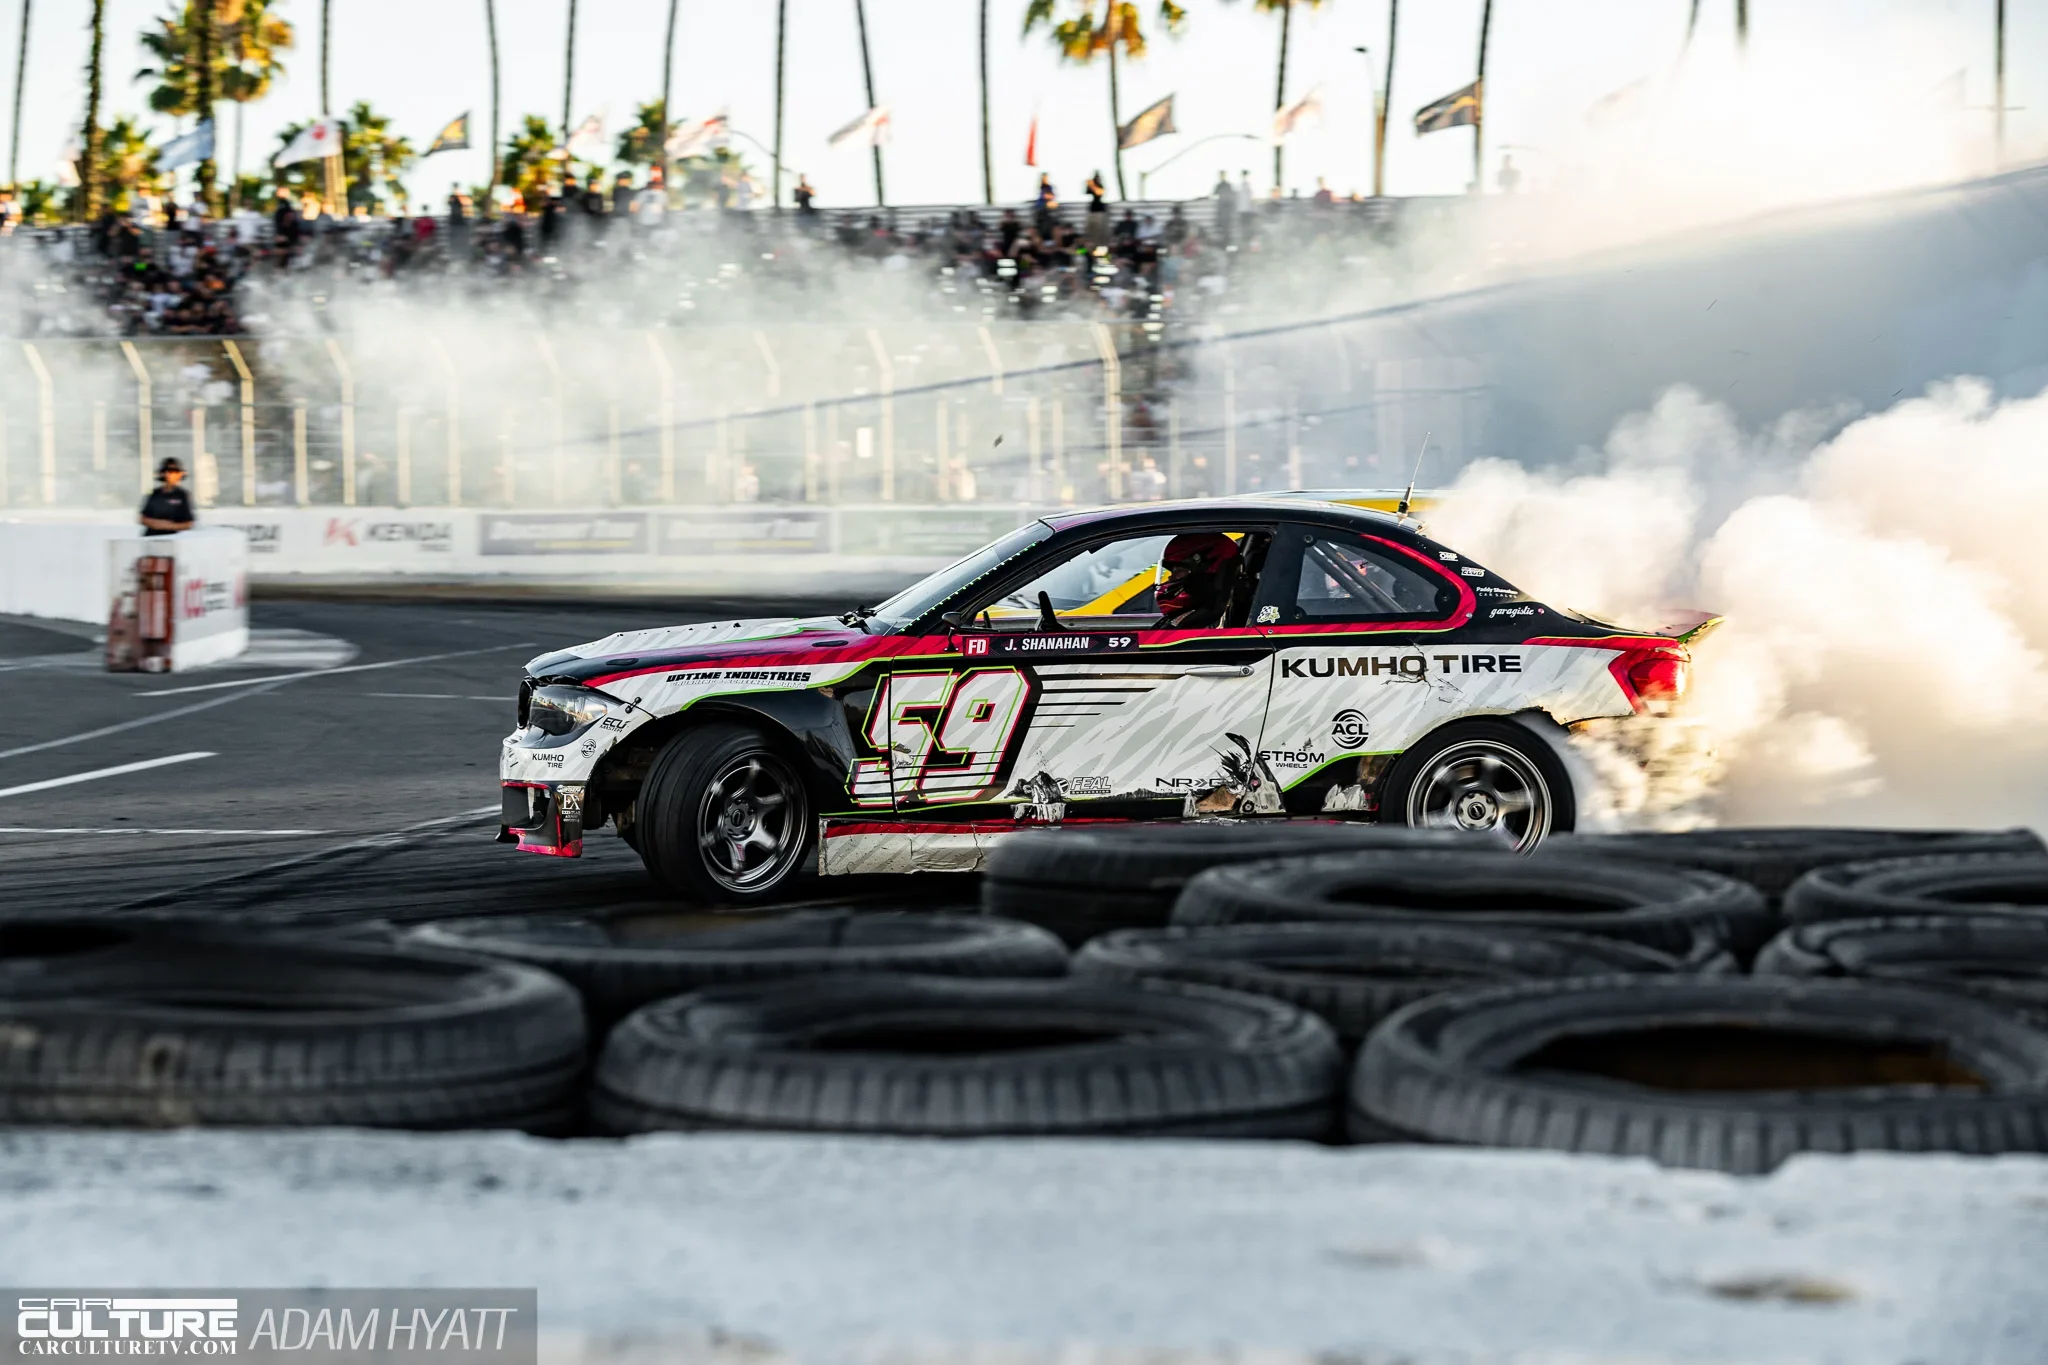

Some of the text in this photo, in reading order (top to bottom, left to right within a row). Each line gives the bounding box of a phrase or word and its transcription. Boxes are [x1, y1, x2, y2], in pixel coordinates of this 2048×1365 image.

[1489, 605, 1535, 618] garagistic
[968, 637, 1131, 654] FD J. SHANAHAN 59
[1281, 654, 1522, 678] KUMHO TIRE
[666, 671, 811, 682] UPTIME INDUSTRIES
[846, 666, 1031, 807] 59
[1331, 723, 1369, 736] ACL
[532, 753, 564, 762] KUMHO
[1260, 748, 1325, 763] STRÖM
[1070, 776, 1111, 790] FEAL
